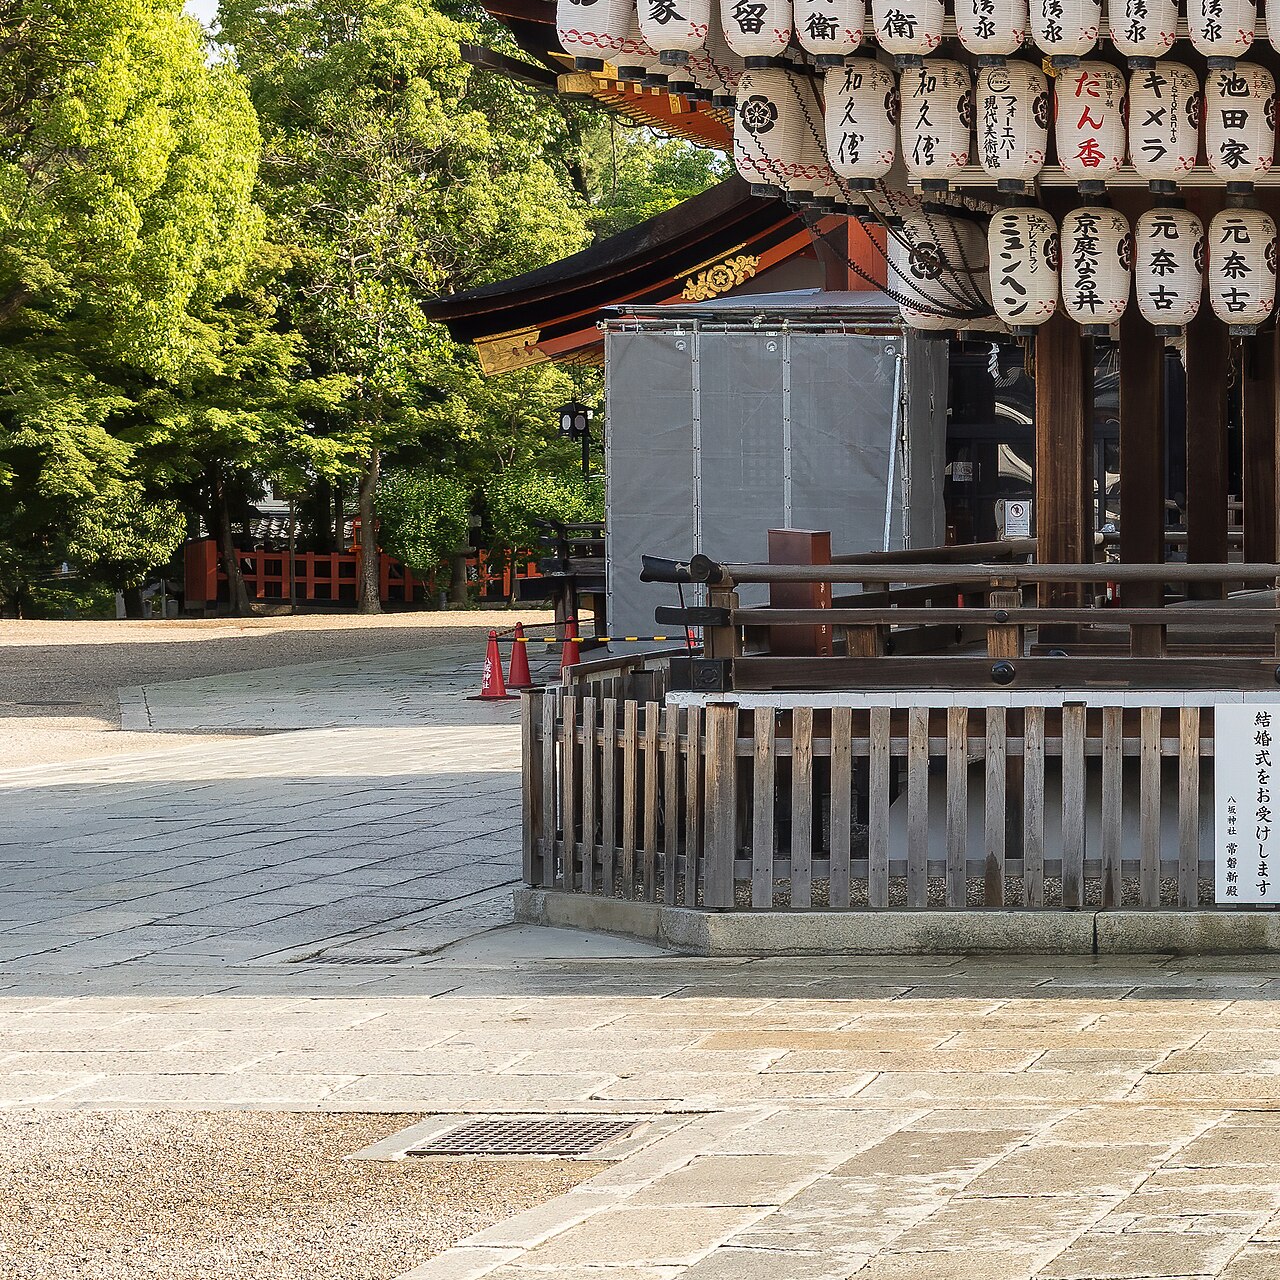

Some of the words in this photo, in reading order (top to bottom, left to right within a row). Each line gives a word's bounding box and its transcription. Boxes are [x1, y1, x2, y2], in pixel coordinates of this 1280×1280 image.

[983, 96, 1001, 168] 現代美術館
[999, 95, 1018, 160] フォーエバー
[1073, 71, 1105, 168] だん香
[1141, 71, 1168, 162] キメラ
[1169, 70, 1178, 143] Ristorante
[1217, 71, 1251, 169] 池田家
[1000, 215, 1028, 317] ミュンヘン
[1026, 214, 1038, 273] ビアレストラン
[1072, 213, 1104, 314] 京庭なる井
[1149, 215, 1180, 310] 元奈古
[1220, 219, 1252, 312] 元奈古
[1227, 795, 1237, 836] 八坂神社
[1254, 711, 1272, 896] 結婚式をお受けします
[1225, 842, 1238, 897] 常磐新殿
